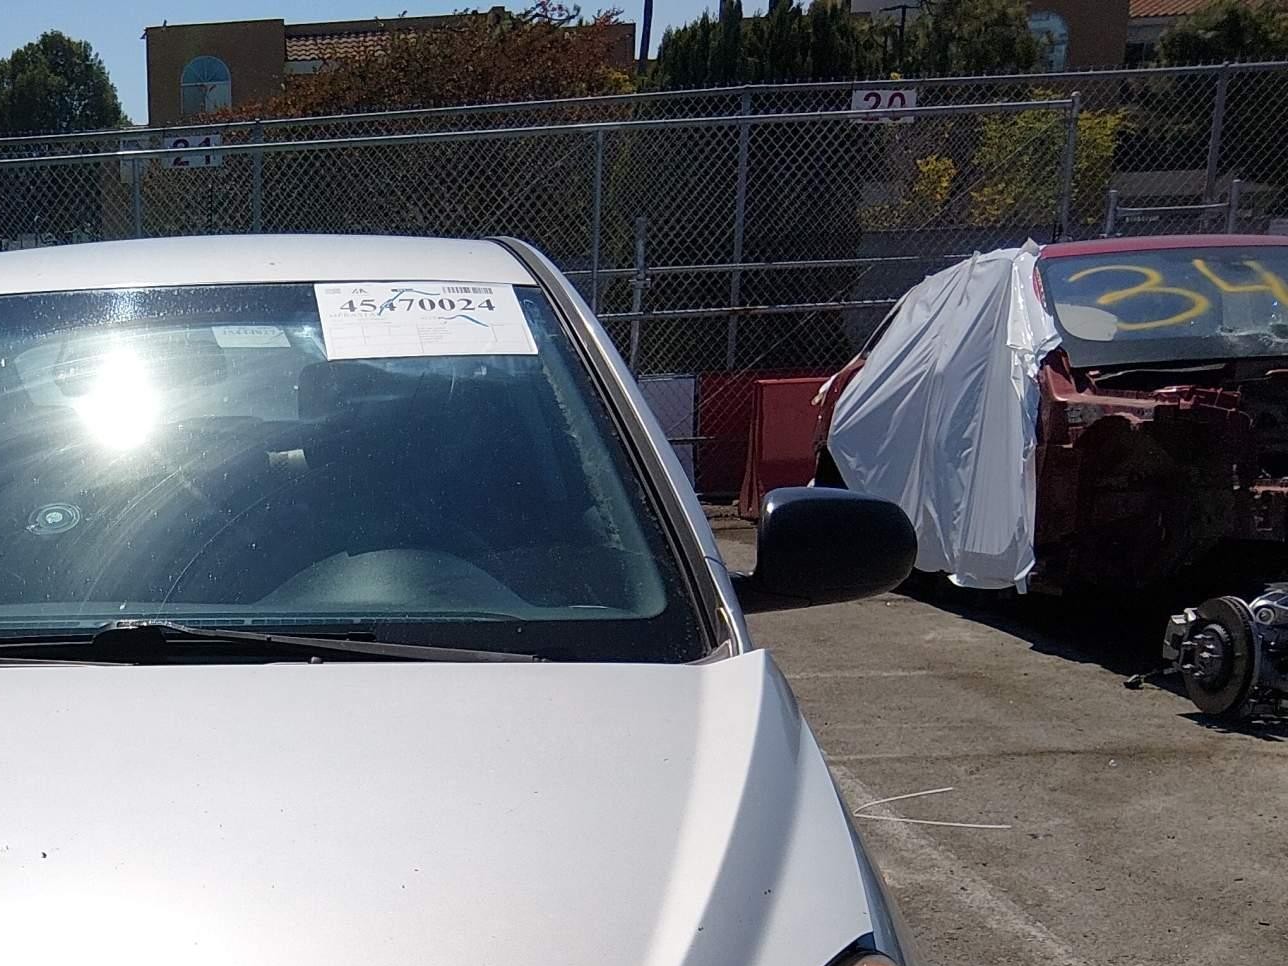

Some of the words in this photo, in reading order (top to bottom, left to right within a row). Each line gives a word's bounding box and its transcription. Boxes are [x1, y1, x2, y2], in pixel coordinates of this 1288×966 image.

[860, 91, 906, 122] 20
[172, 136, 211, 166] 21
[340, 297, 496, 313] 45470024
